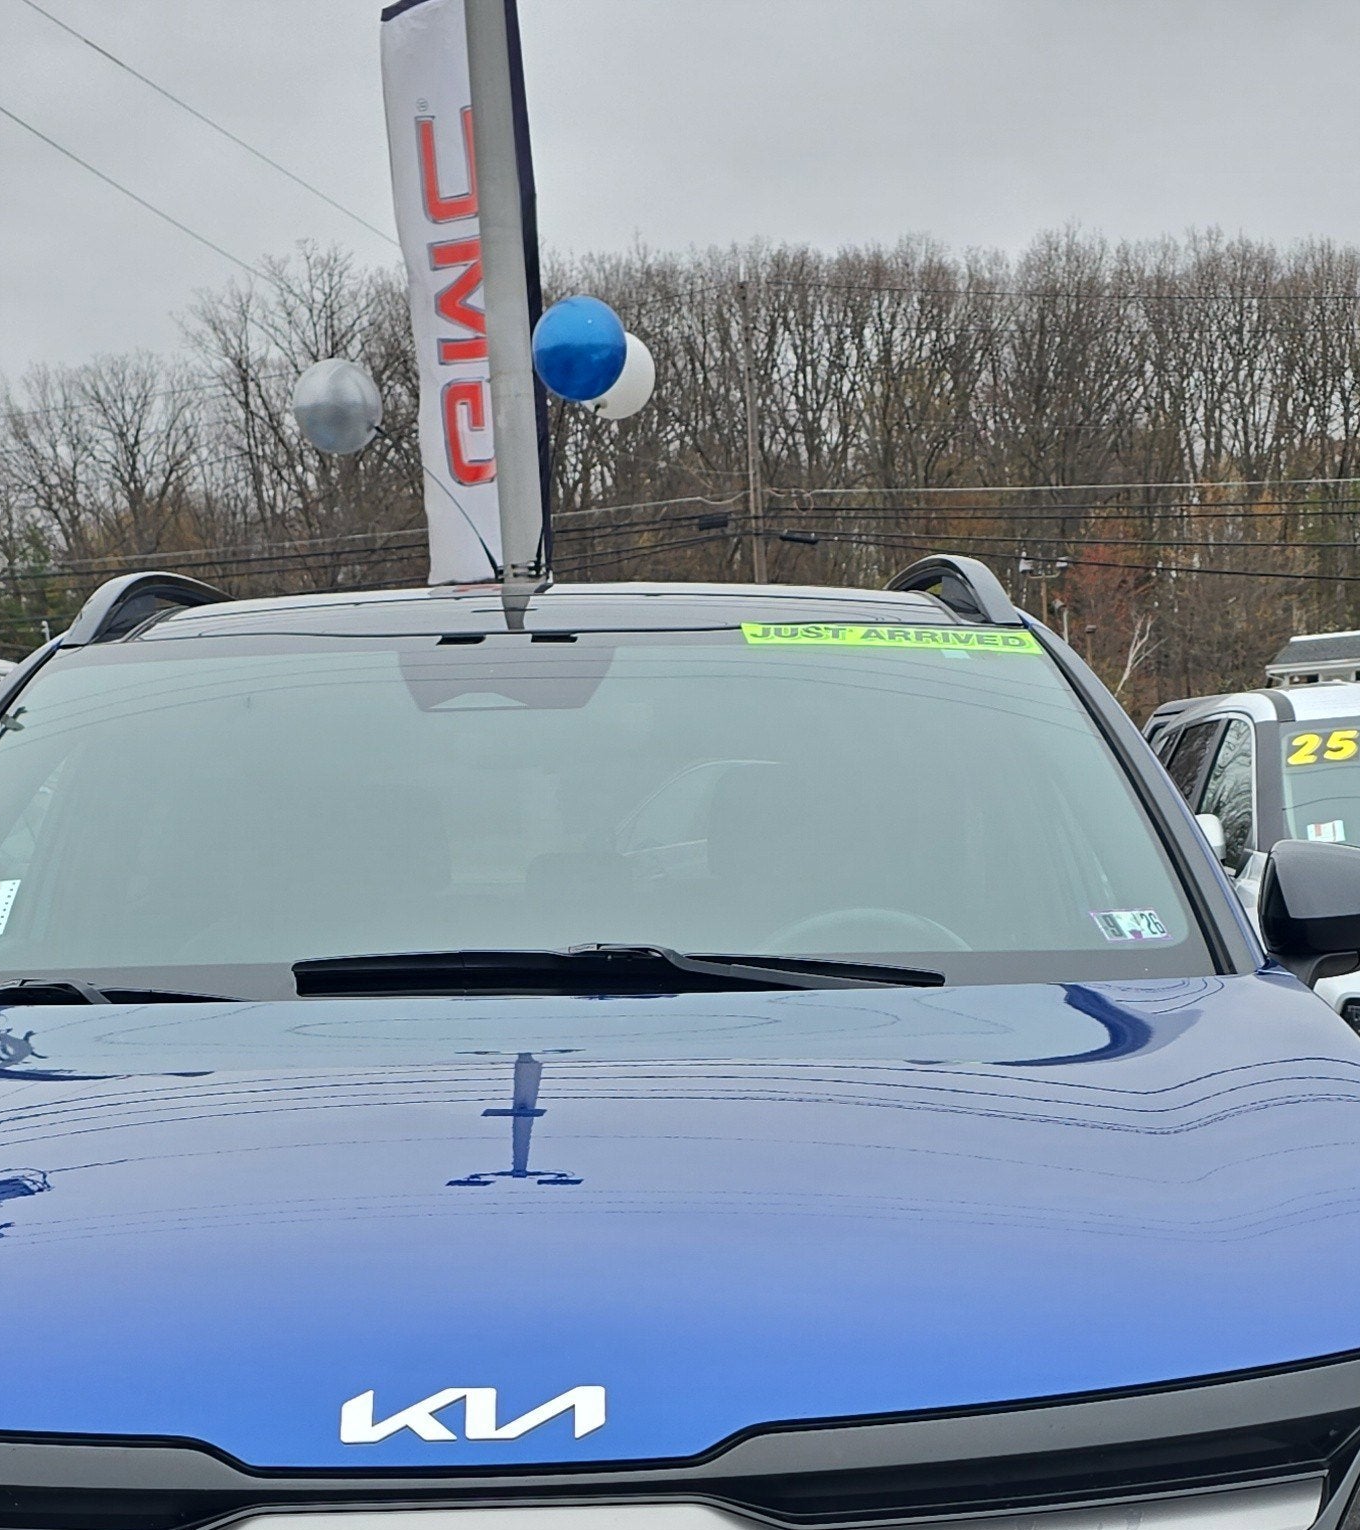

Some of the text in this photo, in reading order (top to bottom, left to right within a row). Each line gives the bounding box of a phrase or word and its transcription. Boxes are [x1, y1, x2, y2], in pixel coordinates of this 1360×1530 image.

[750, 625, 1028, 649] JUST ARRIVED
[1286, 729, 1360, 766] 25
[1139, 912, 1166, 936] 26
[340, 1385, 606, 1444] KIA
